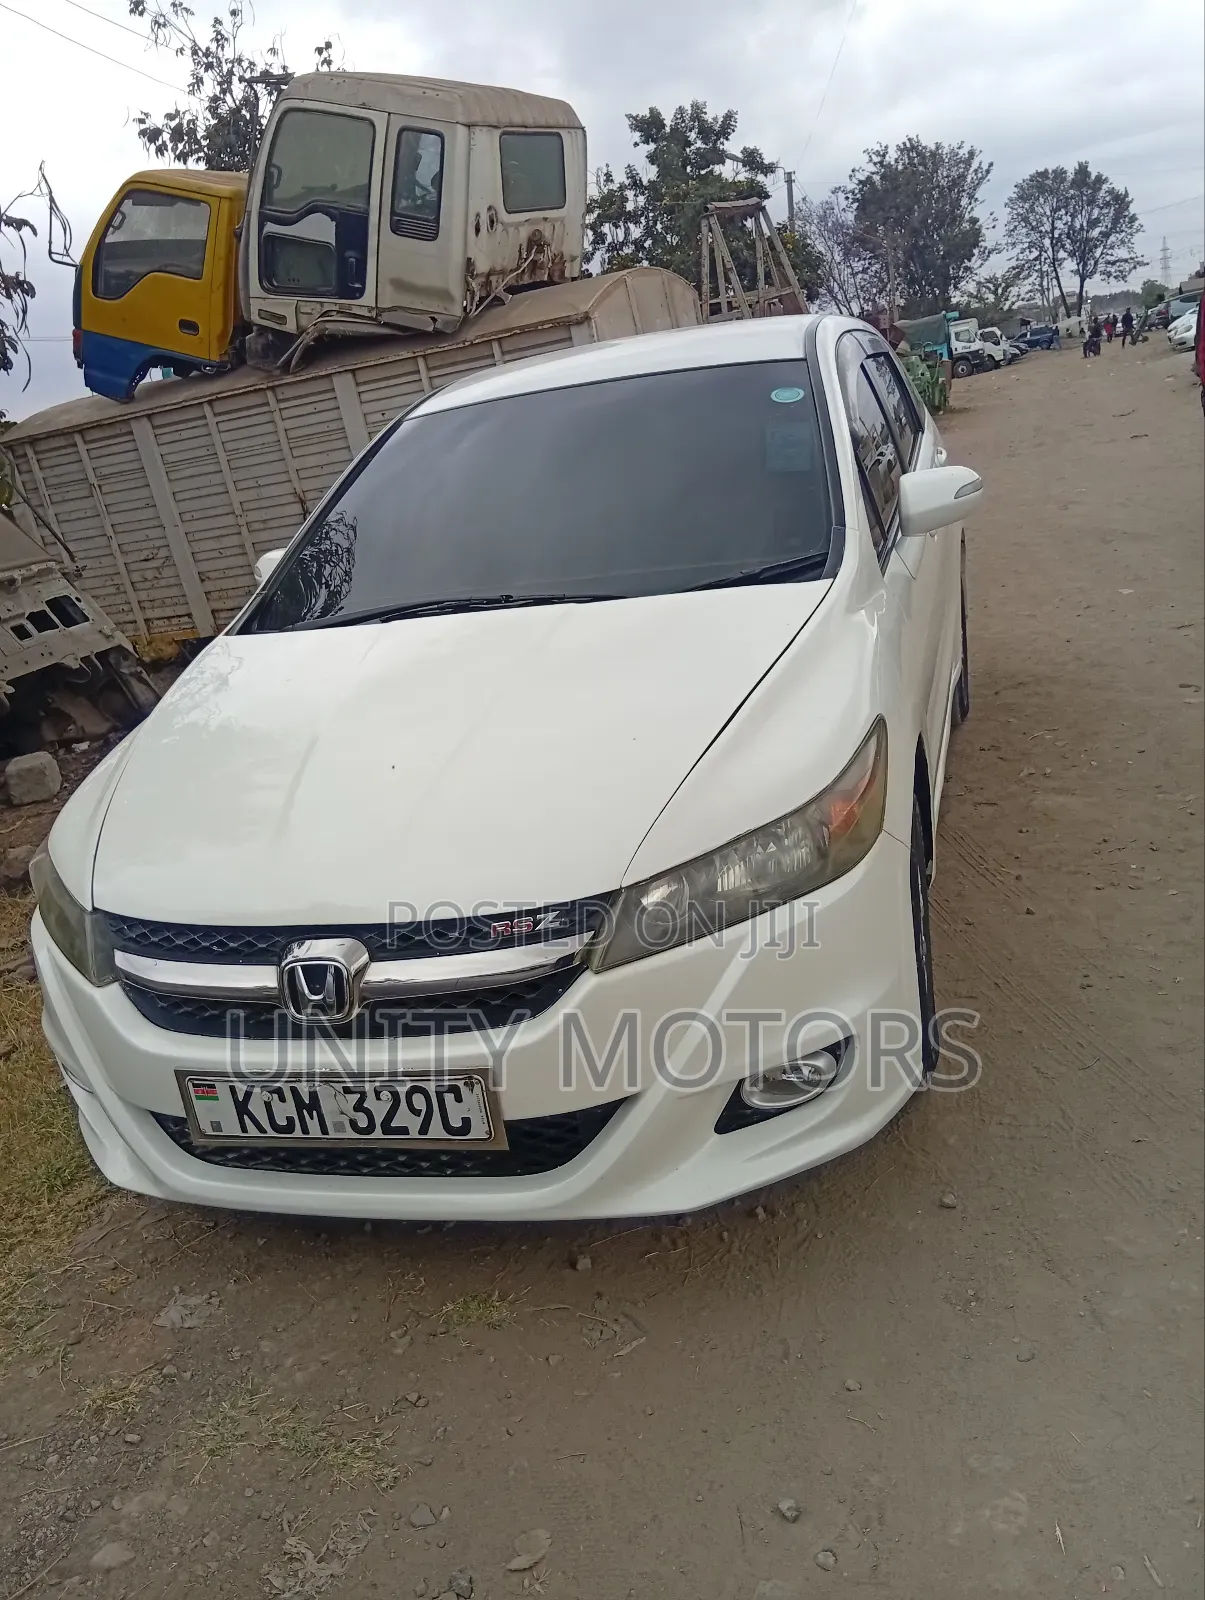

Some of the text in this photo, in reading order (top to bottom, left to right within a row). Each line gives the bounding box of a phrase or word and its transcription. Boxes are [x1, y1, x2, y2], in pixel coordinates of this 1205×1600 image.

[490, 910, 560, 937] RSZ
[228, 1084, 330, 1136] KCM
[346, 1084, 472, 1136] 329C
